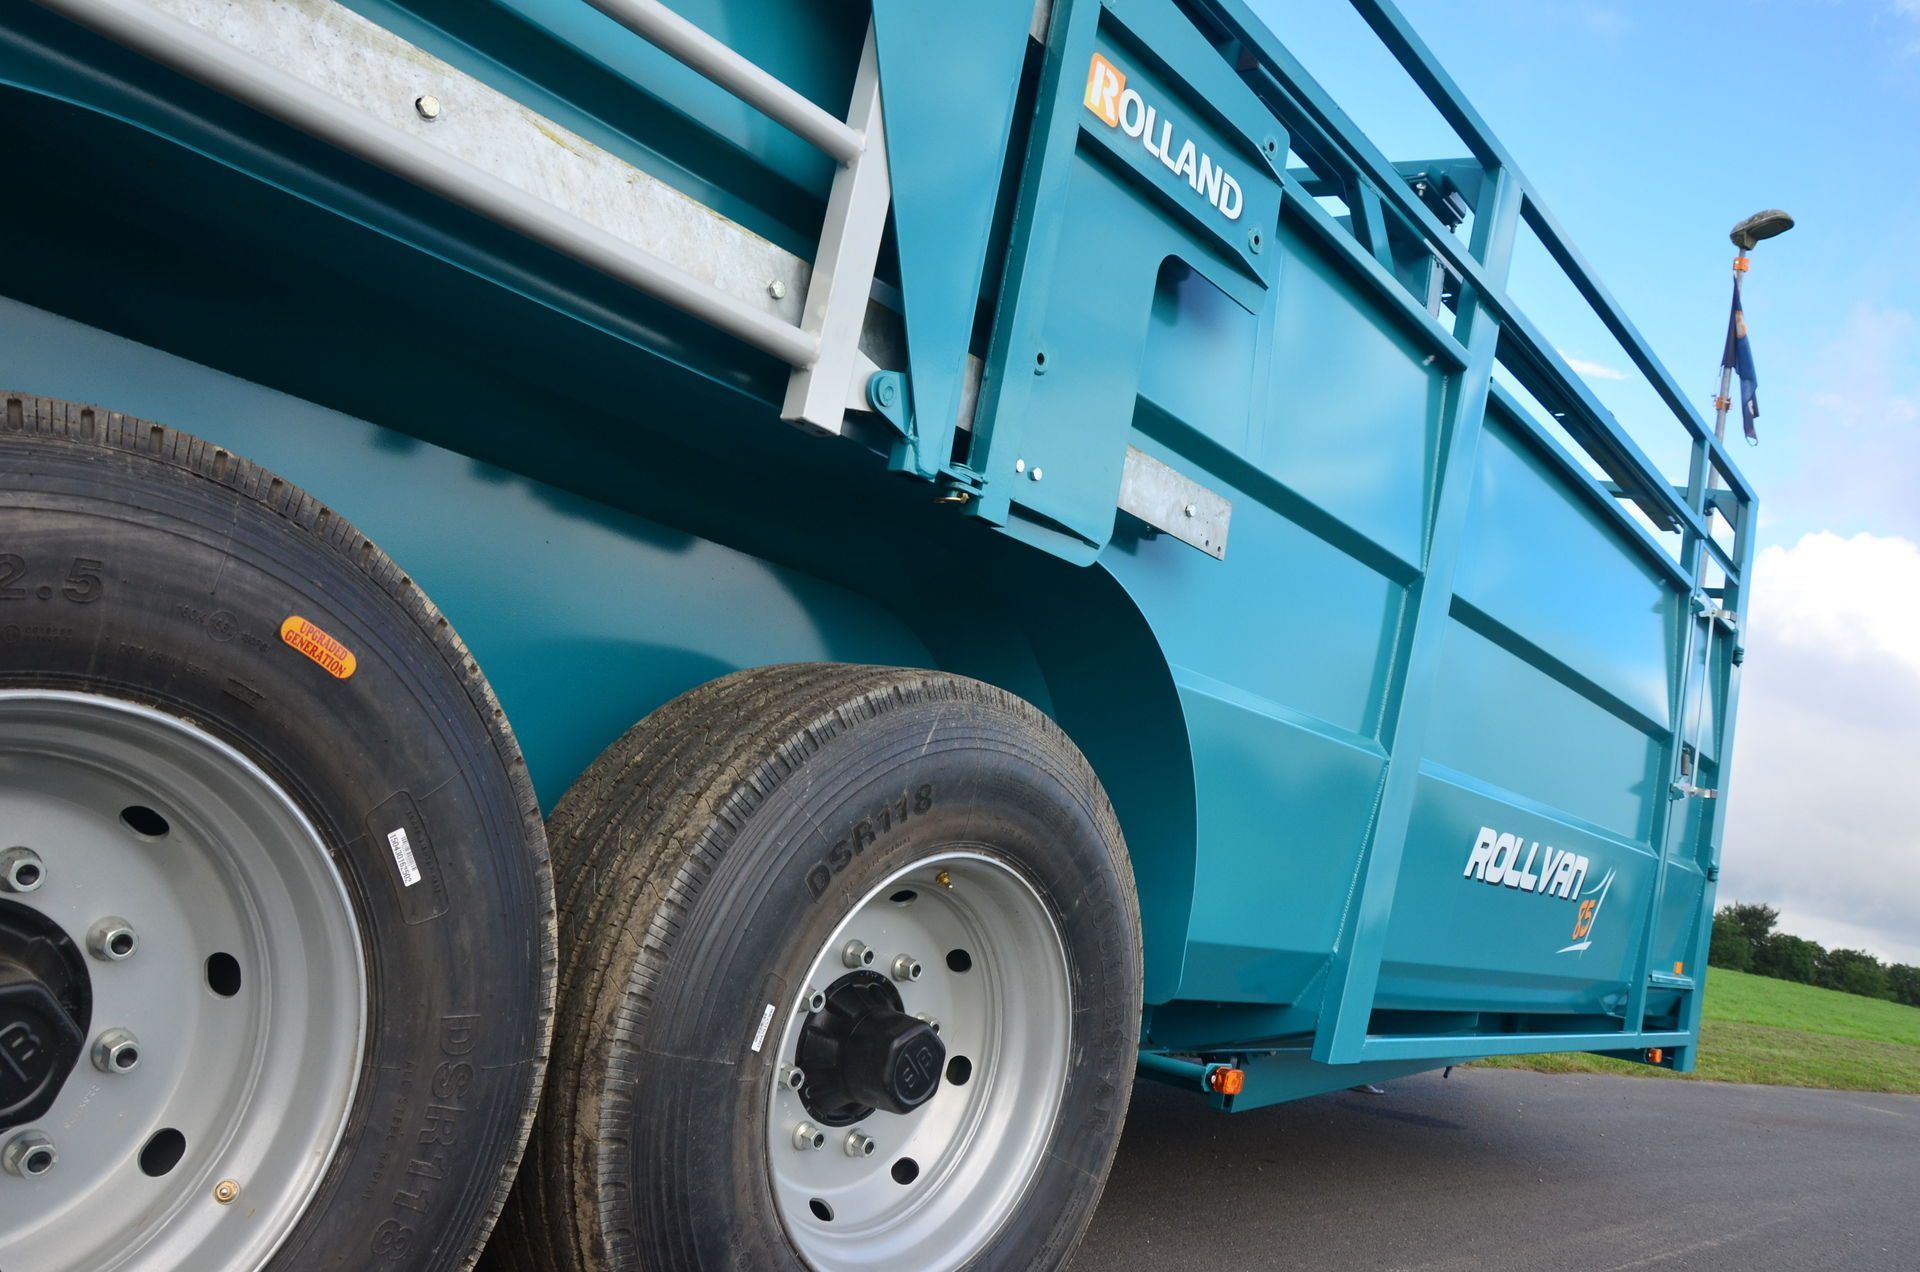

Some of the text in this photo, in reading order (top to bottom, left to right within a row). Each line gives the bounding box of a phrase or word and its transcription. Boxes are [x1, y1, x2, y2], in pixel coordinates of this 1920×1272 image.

[1088, 59, 1243, 220] ROLLAND
[285, 629, 347, 677] GENERATION
[300, 621, 348, 661] UPGRADED
[804, 782, 933, 904] DSR118
[1463, 826, 1589, 900] ROLLVAN
[370, 1013, 482, 1262] DSR118
